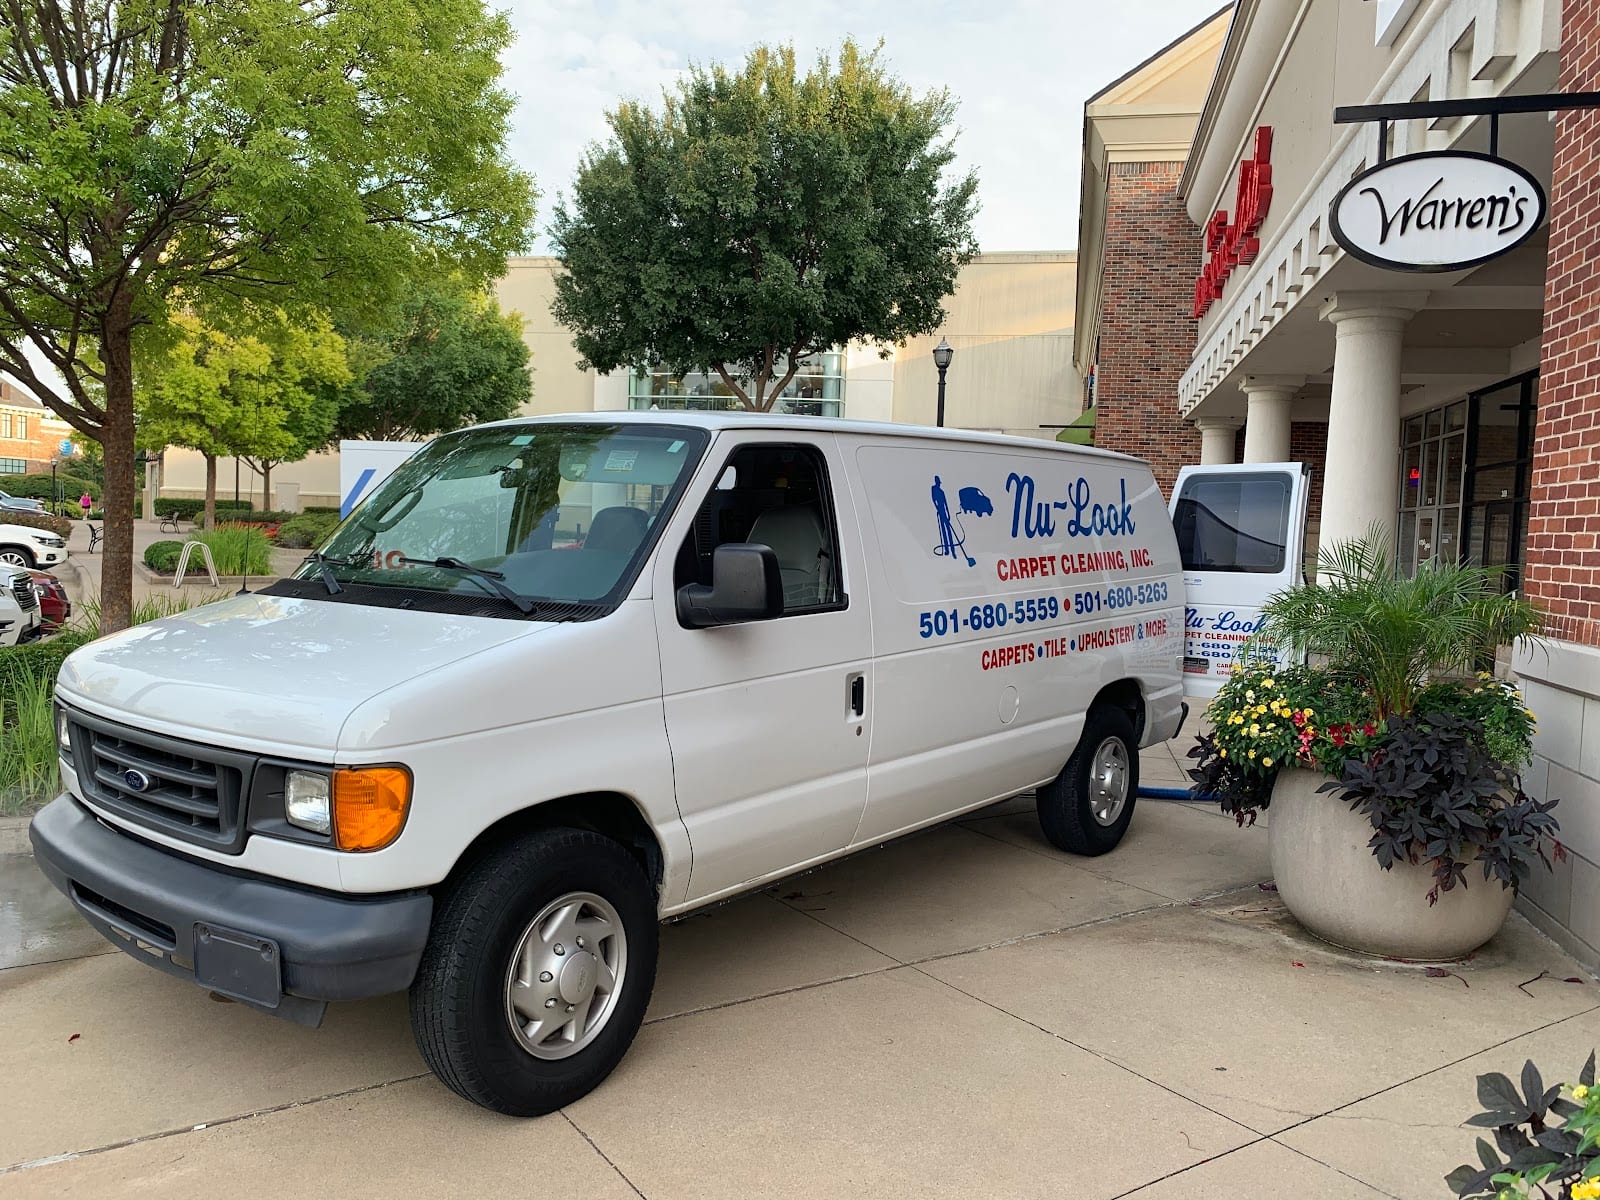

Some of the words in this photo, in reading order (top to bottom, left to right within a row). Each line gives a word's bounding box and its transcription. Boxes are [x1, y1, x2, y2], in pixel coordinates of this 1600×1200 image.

[1359, 177, 1528, 245] Warren's
[1005, 472, 1136, 538] Nu-Look
[996, 555, 1056, 581] CARPET
[1061, 550, 1129, 572] CLEANING,
[1130, 548, 1154, 568] INC.
[919, 596, 1059, 639] 501-680-5559
[1074, 581, 1168, 615] 501-680-5263
[981, 643, 1035, 671] CARPETS
[1044, 637, 1067, 658] TILE
[1078, 624, 1136, 652] UPHOLSTERY
[1137, 623, 1144, 640] &
[1145, 618, 1167, 638] MORE
